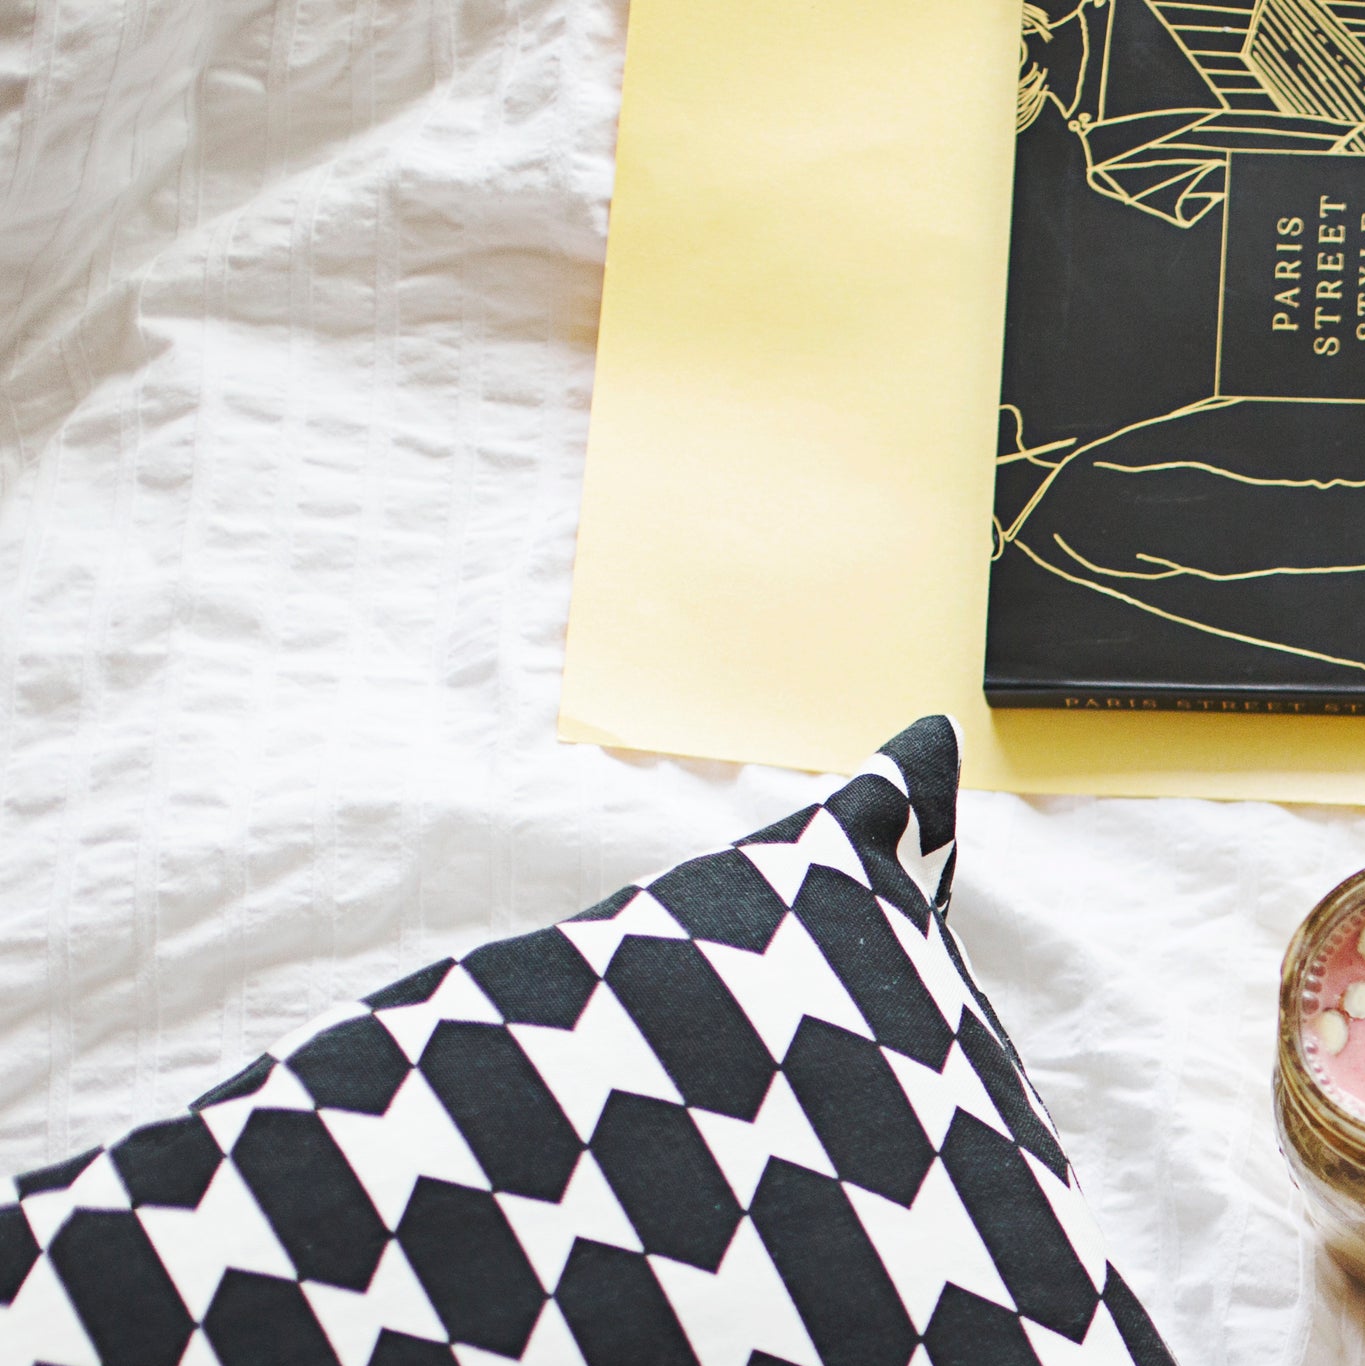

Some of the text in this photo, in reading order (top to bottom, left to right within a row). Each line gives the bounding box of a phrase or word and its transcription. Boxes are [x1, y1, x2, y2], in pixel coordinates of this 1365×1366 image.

[1272, 216, 1304, 331] PARIS
[1313, 195, 1347, 356] STREET
[1065, 698, 1157, 709] PARIS
[1177, 700, 1305, 711] STREET
